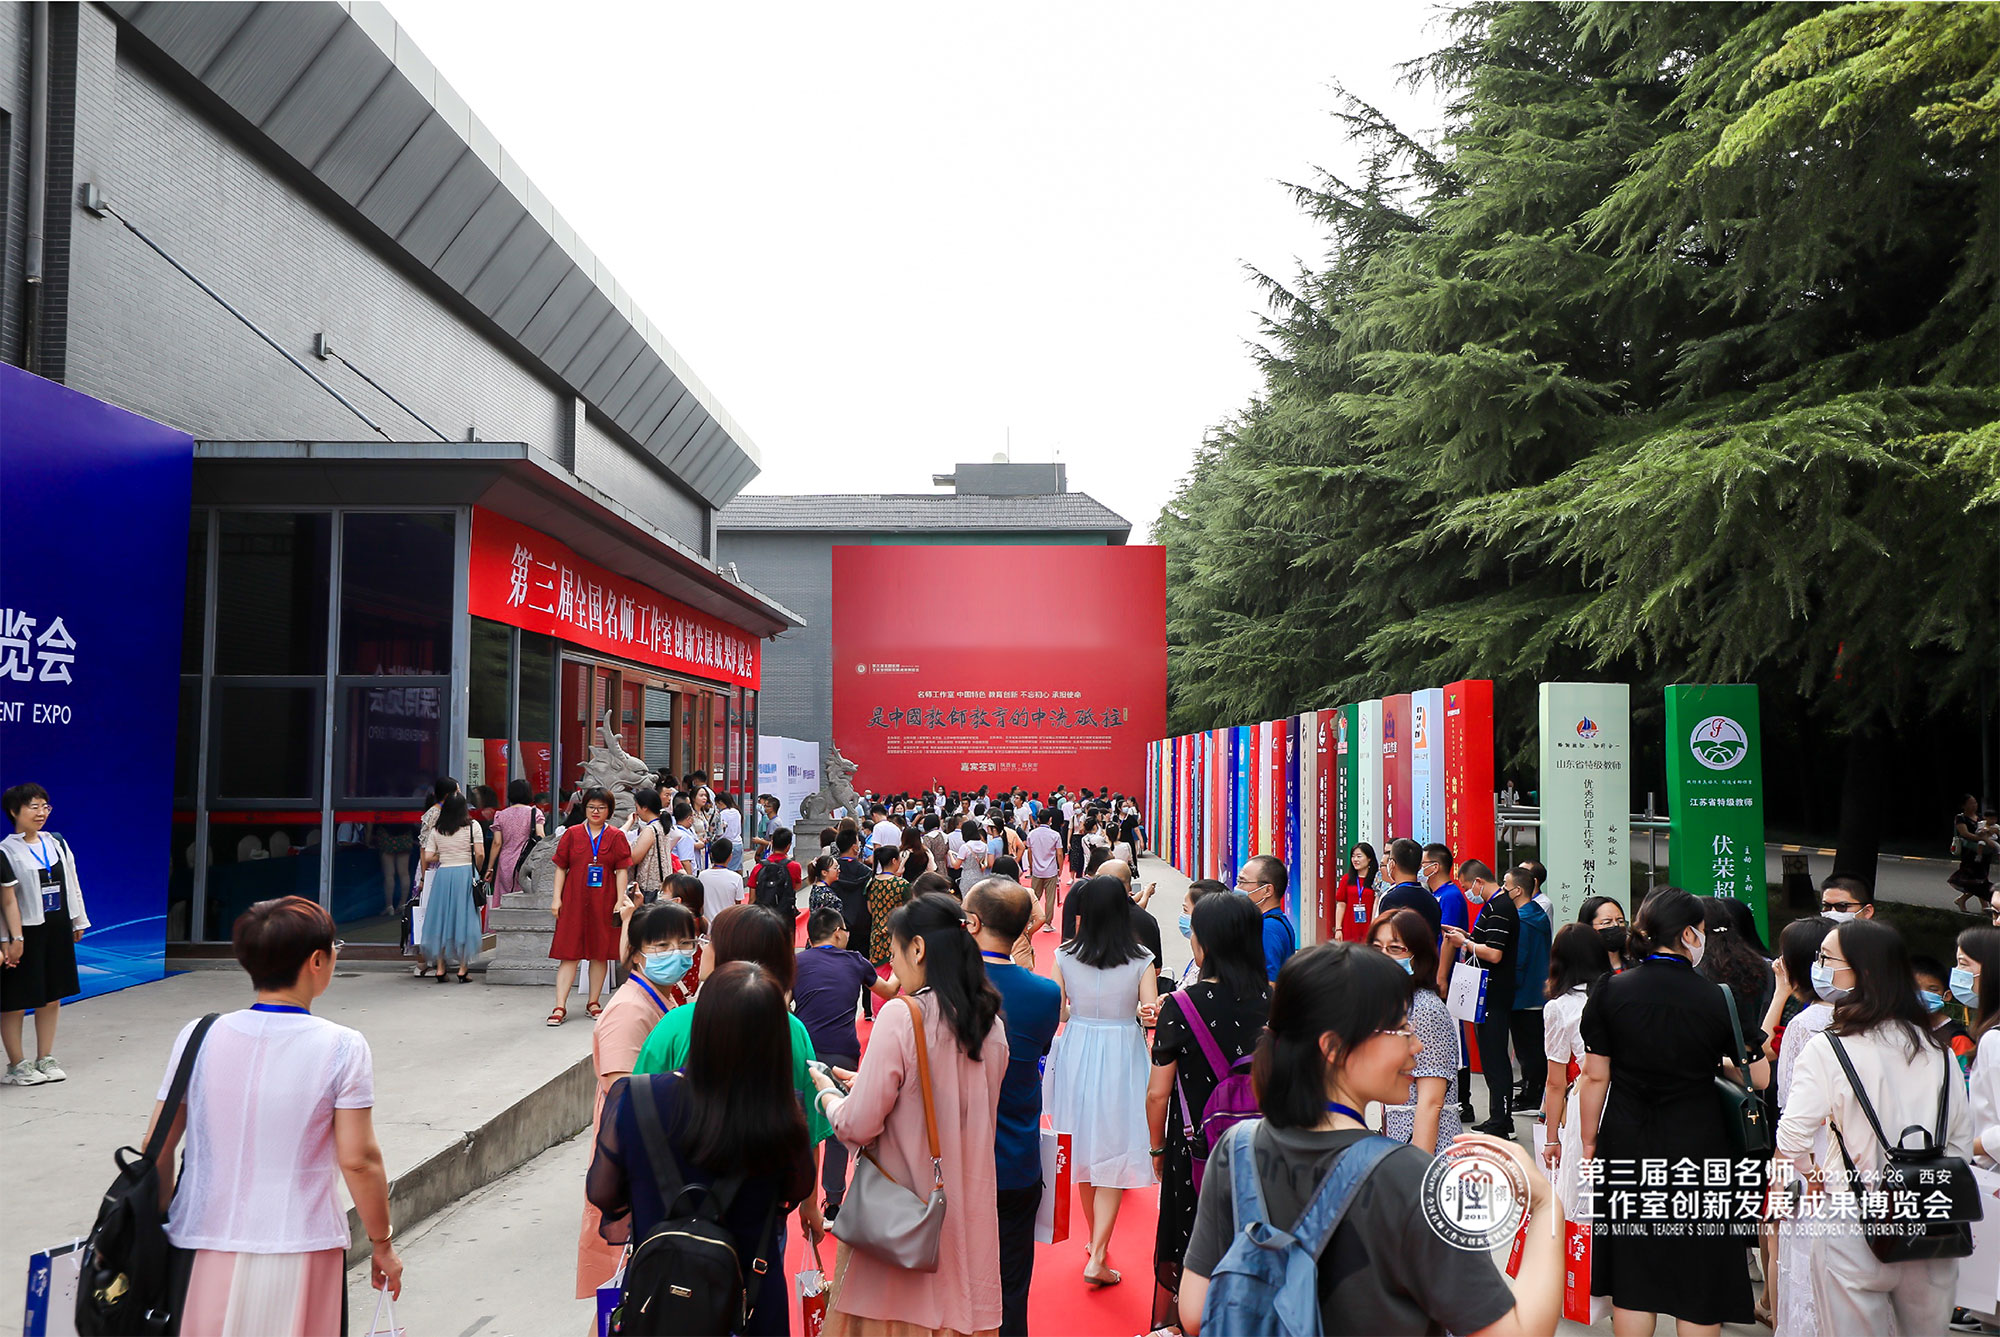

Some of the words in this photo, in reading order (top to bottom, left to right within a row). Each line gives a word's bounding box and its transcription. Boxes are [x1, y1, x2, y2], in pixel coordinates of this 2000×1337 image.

[33, 703, 72, 725] EXPO
[1556, 759, 1622, 770] 山东省特级教师
[1689, 798, 1753, 807] 江苏省特级教师
[1712, 835, 1735, 899] 伏荣超
